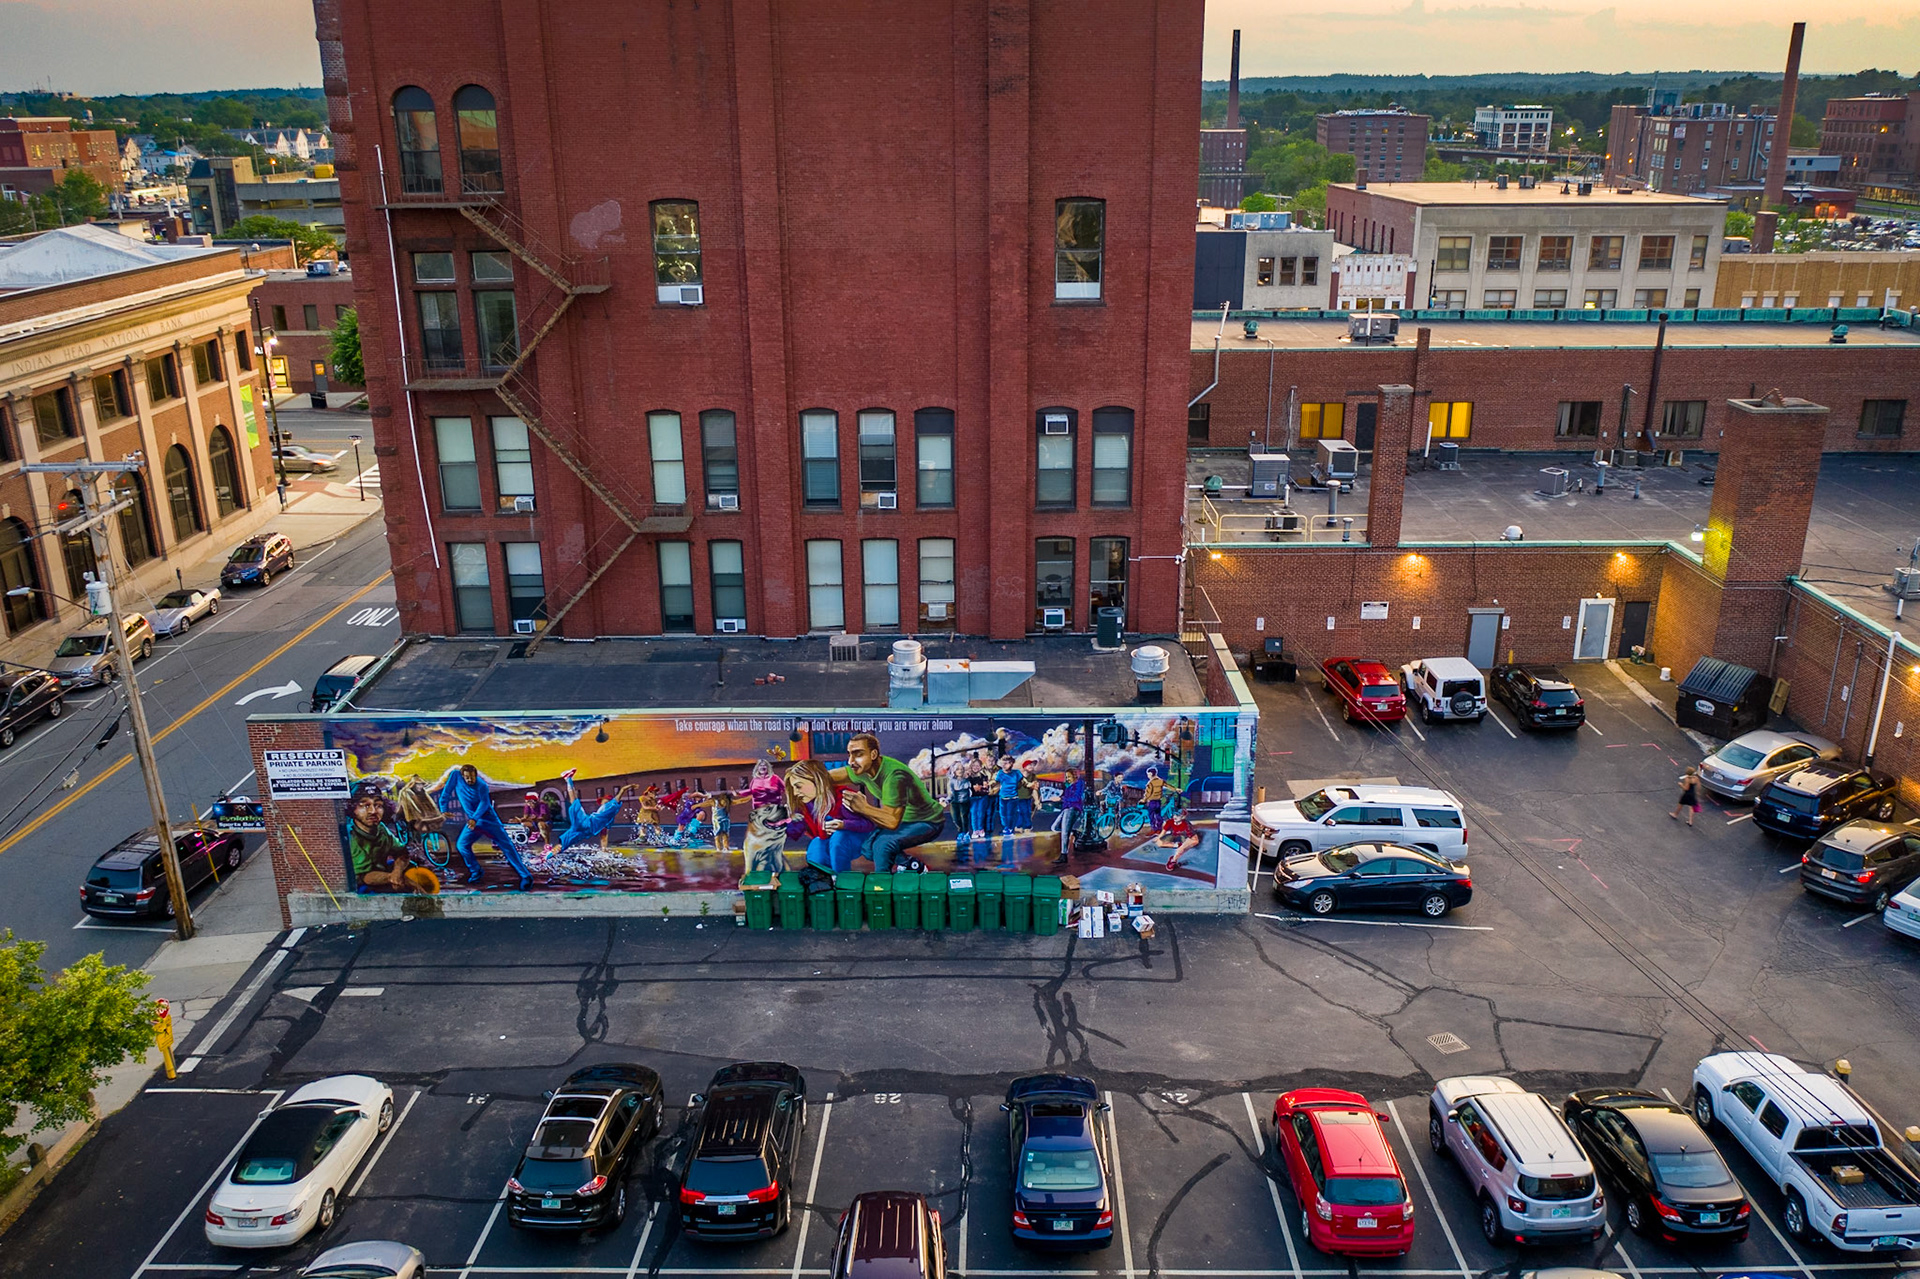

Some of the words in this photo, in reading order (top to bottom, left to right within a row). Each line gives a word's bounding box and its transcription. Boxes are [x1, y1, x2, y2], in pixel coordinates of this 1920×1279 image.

[12, 354, 52, 375] INDIAN
[64, 343, 91, 359] HEAD
[102, 330, 150, 348] NATIONAL
[160, 318, 183, 333] BANK
[674, 720, 693, 731] Take
[694, 720, 725, 733] courage
[727, 720, 748, 731] when
[750, 720, 762, 731] the
[764, 720, 781, 731] road
[783, 720, 790, 731] is
[793, 720, 809, 732] lng
[812, 719, 830, 731] don't
[832, 720, 848, 731] ever
[851, 719, 876, 732] forget,
[878, 720, 892, 732] you
[894, 720, 906, 731] are
[908, 720, 930, 731] never
[932, 719, 953, 731] alone
[271, 752, 338, 760] RESERVED
